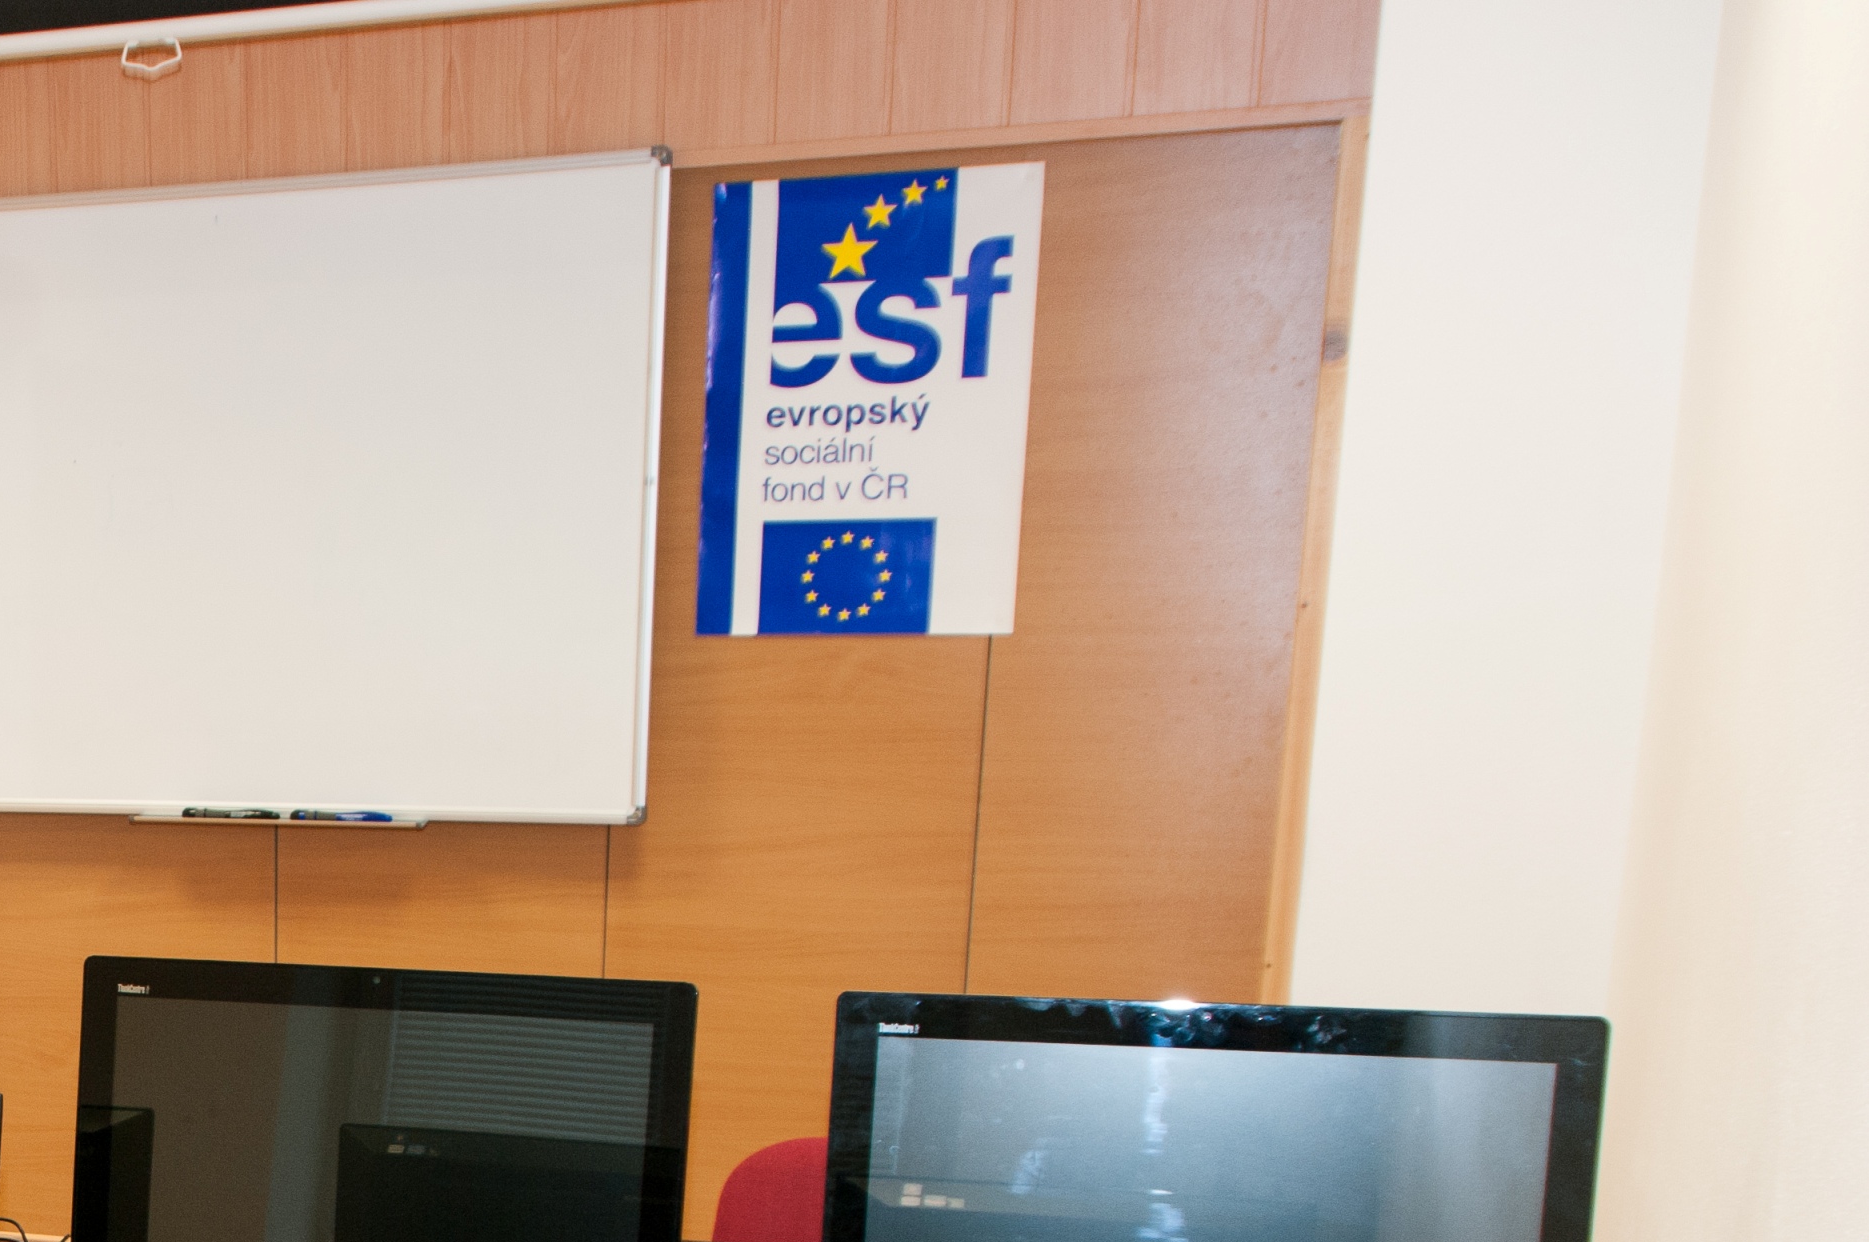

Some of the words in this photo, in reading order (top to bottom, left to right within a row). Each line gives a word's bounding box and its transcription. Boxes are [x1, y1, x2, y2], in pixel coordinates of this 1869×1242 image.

[770, 235, 1014, 388] esf
[766, 394, 930, 432] evropský
[764, 437, 875, 465] sociální
[762, 475, 824, 501] fond
[836, 481, 851, 501] v
[861, 467, 908, 500] ČR
